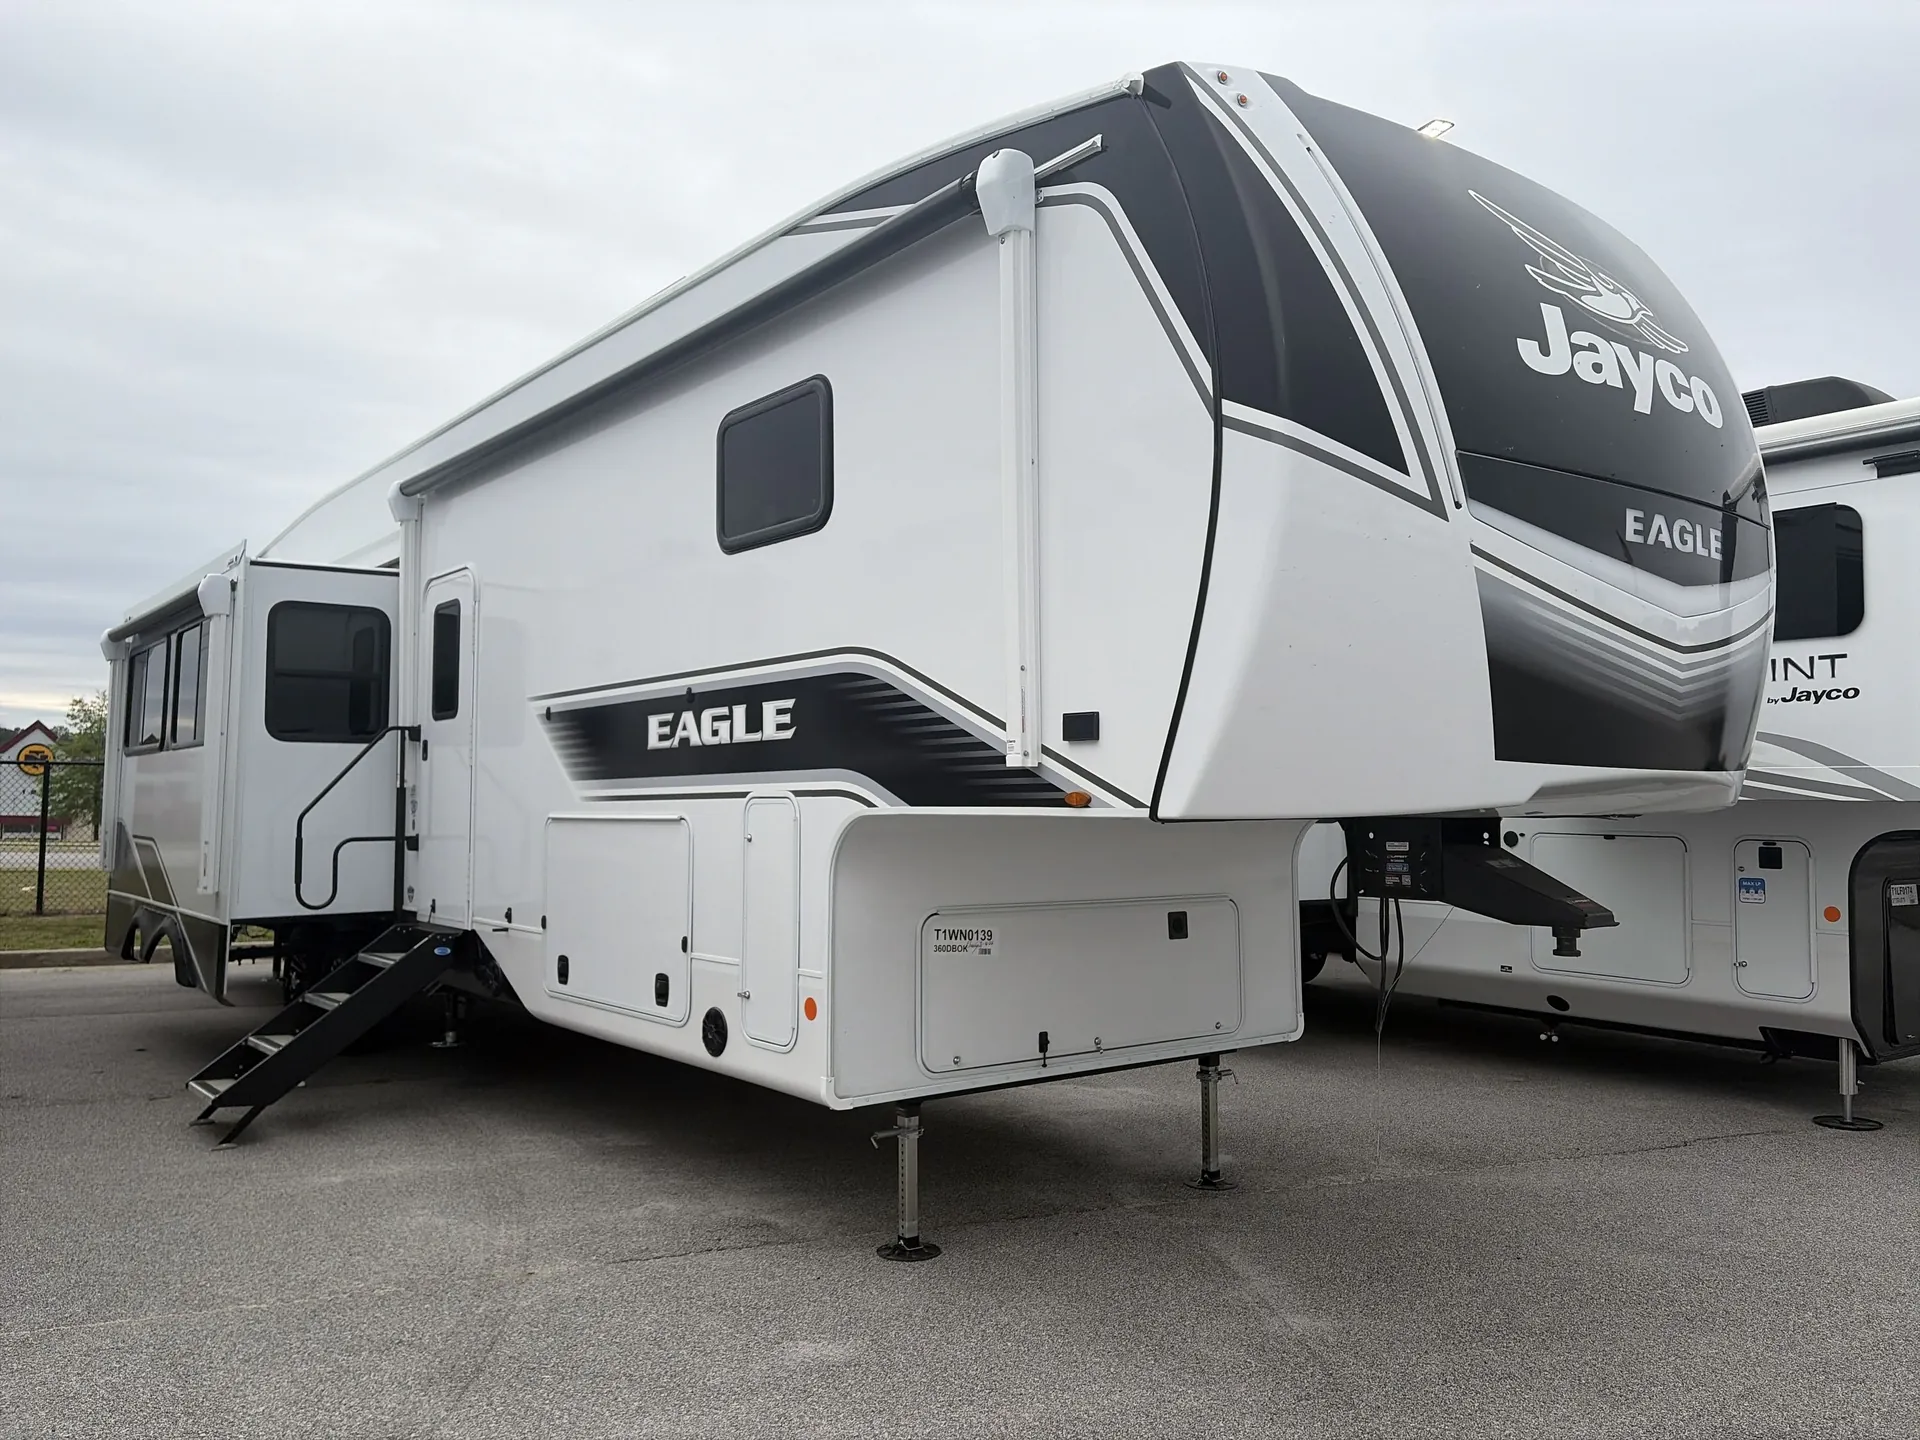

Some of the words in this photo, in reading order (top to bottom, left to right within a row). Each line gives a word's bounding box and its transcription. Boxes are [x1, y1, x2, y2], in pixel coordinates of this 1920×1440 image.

[1516, 302, 1724, 429] Jayco
[1625, 507, 1723, 561] EAGLE
[1766, 697, 1780, 705] by
[1780, 686, 1861, 705] Jayco
[647, 698, 798, 750] EAGLE
[933, 944, 968, 953] 360DBOK
[934, 929, 993, 941] T1WN0139
